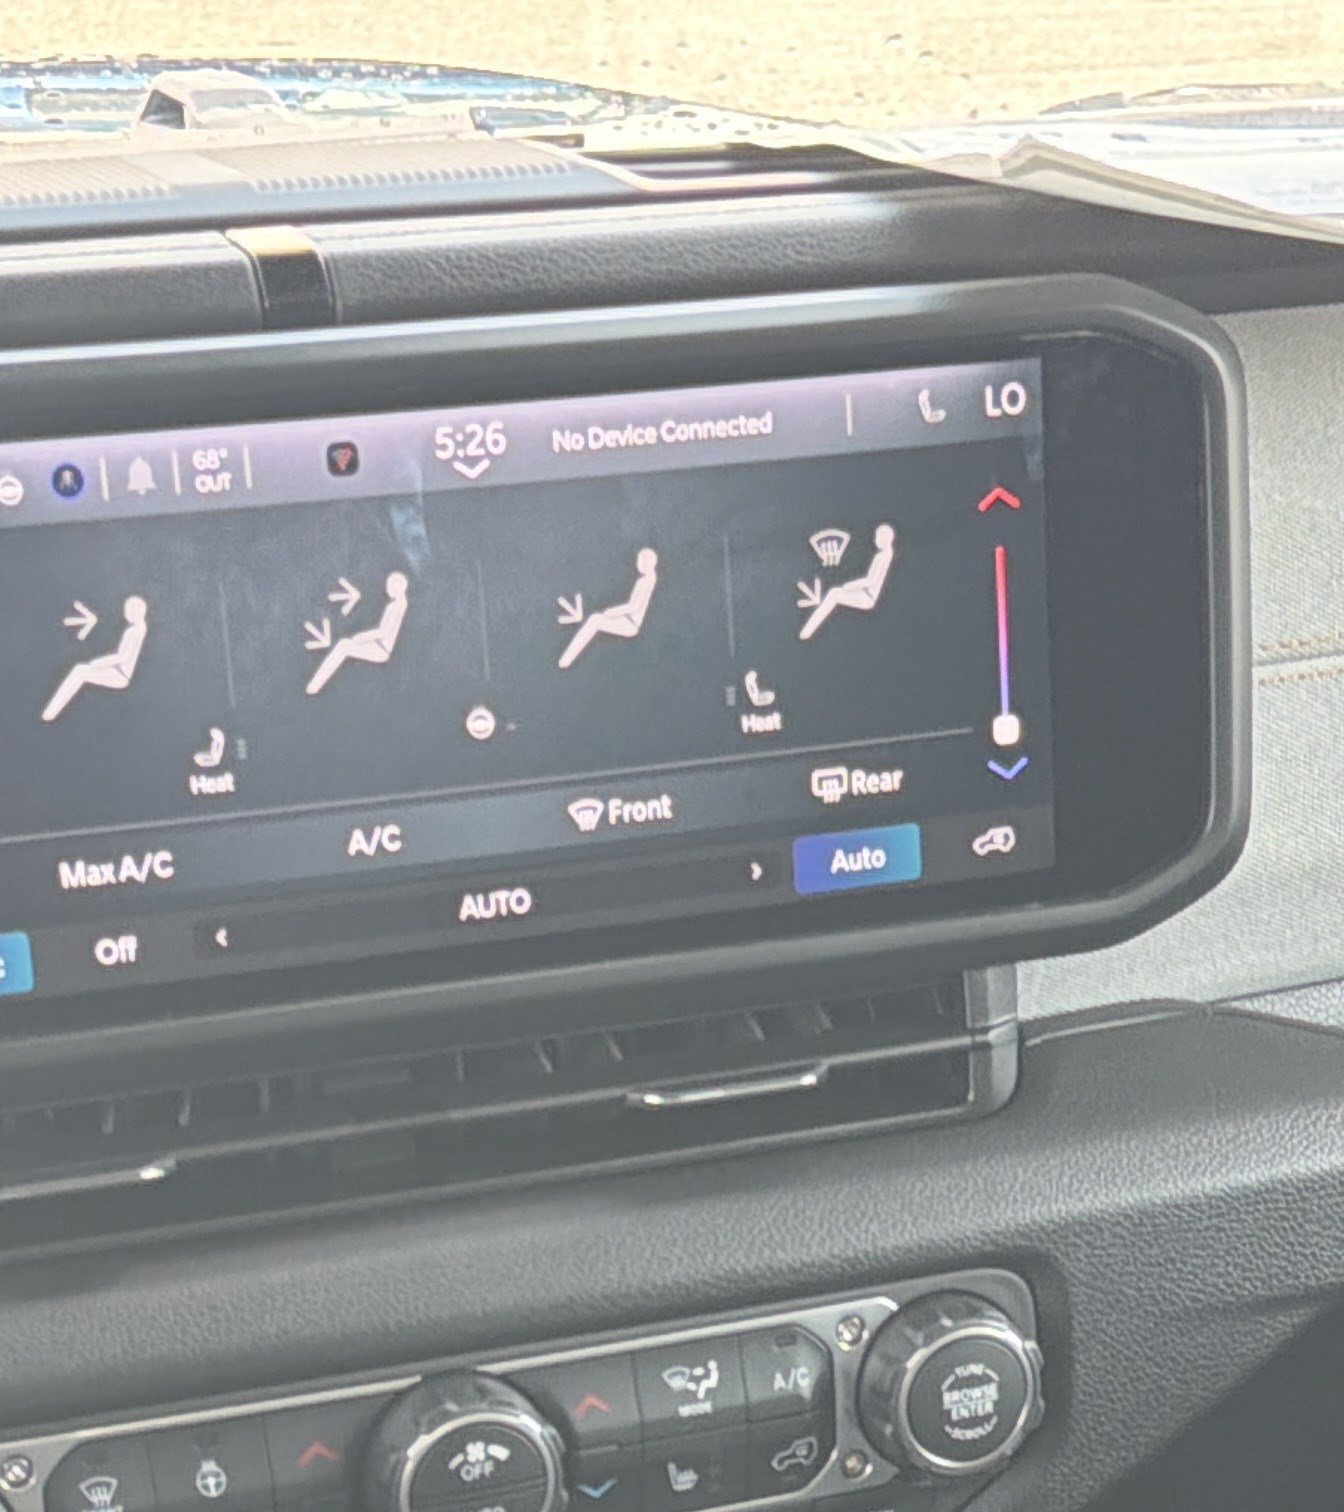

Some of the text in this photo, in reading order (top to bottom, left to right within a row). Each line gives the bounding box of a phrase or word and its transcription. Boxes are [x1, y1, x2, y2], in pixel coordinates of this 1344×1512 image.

[985, 380, 1027, 418] LO
[434, 420, 507, 460] 5:26
[552, 411, 774, 454] No Device Connected
[194, 472, 233, 495] OUT
[740, 711, 782, 735] Heat
[188, 772, 235, 795] Heat
[851, 767, 904, 796] Rear
[607, 793, 673, 824] Front
[347, 824, 403, 858] A/C
[58, 850, 175, 890] Max A/C
[830, 845, 888, 876] Auto
[458, 887, 532, 922] AUTO
[94, 934, 139, 967] Off
[773, 1365, 811, 1393] A/C
[942, 1382, 998, 1406] BROWSE
[950, 1401, 994, 1421] ENTER
[460, 1459, 495, 1482] OFF
